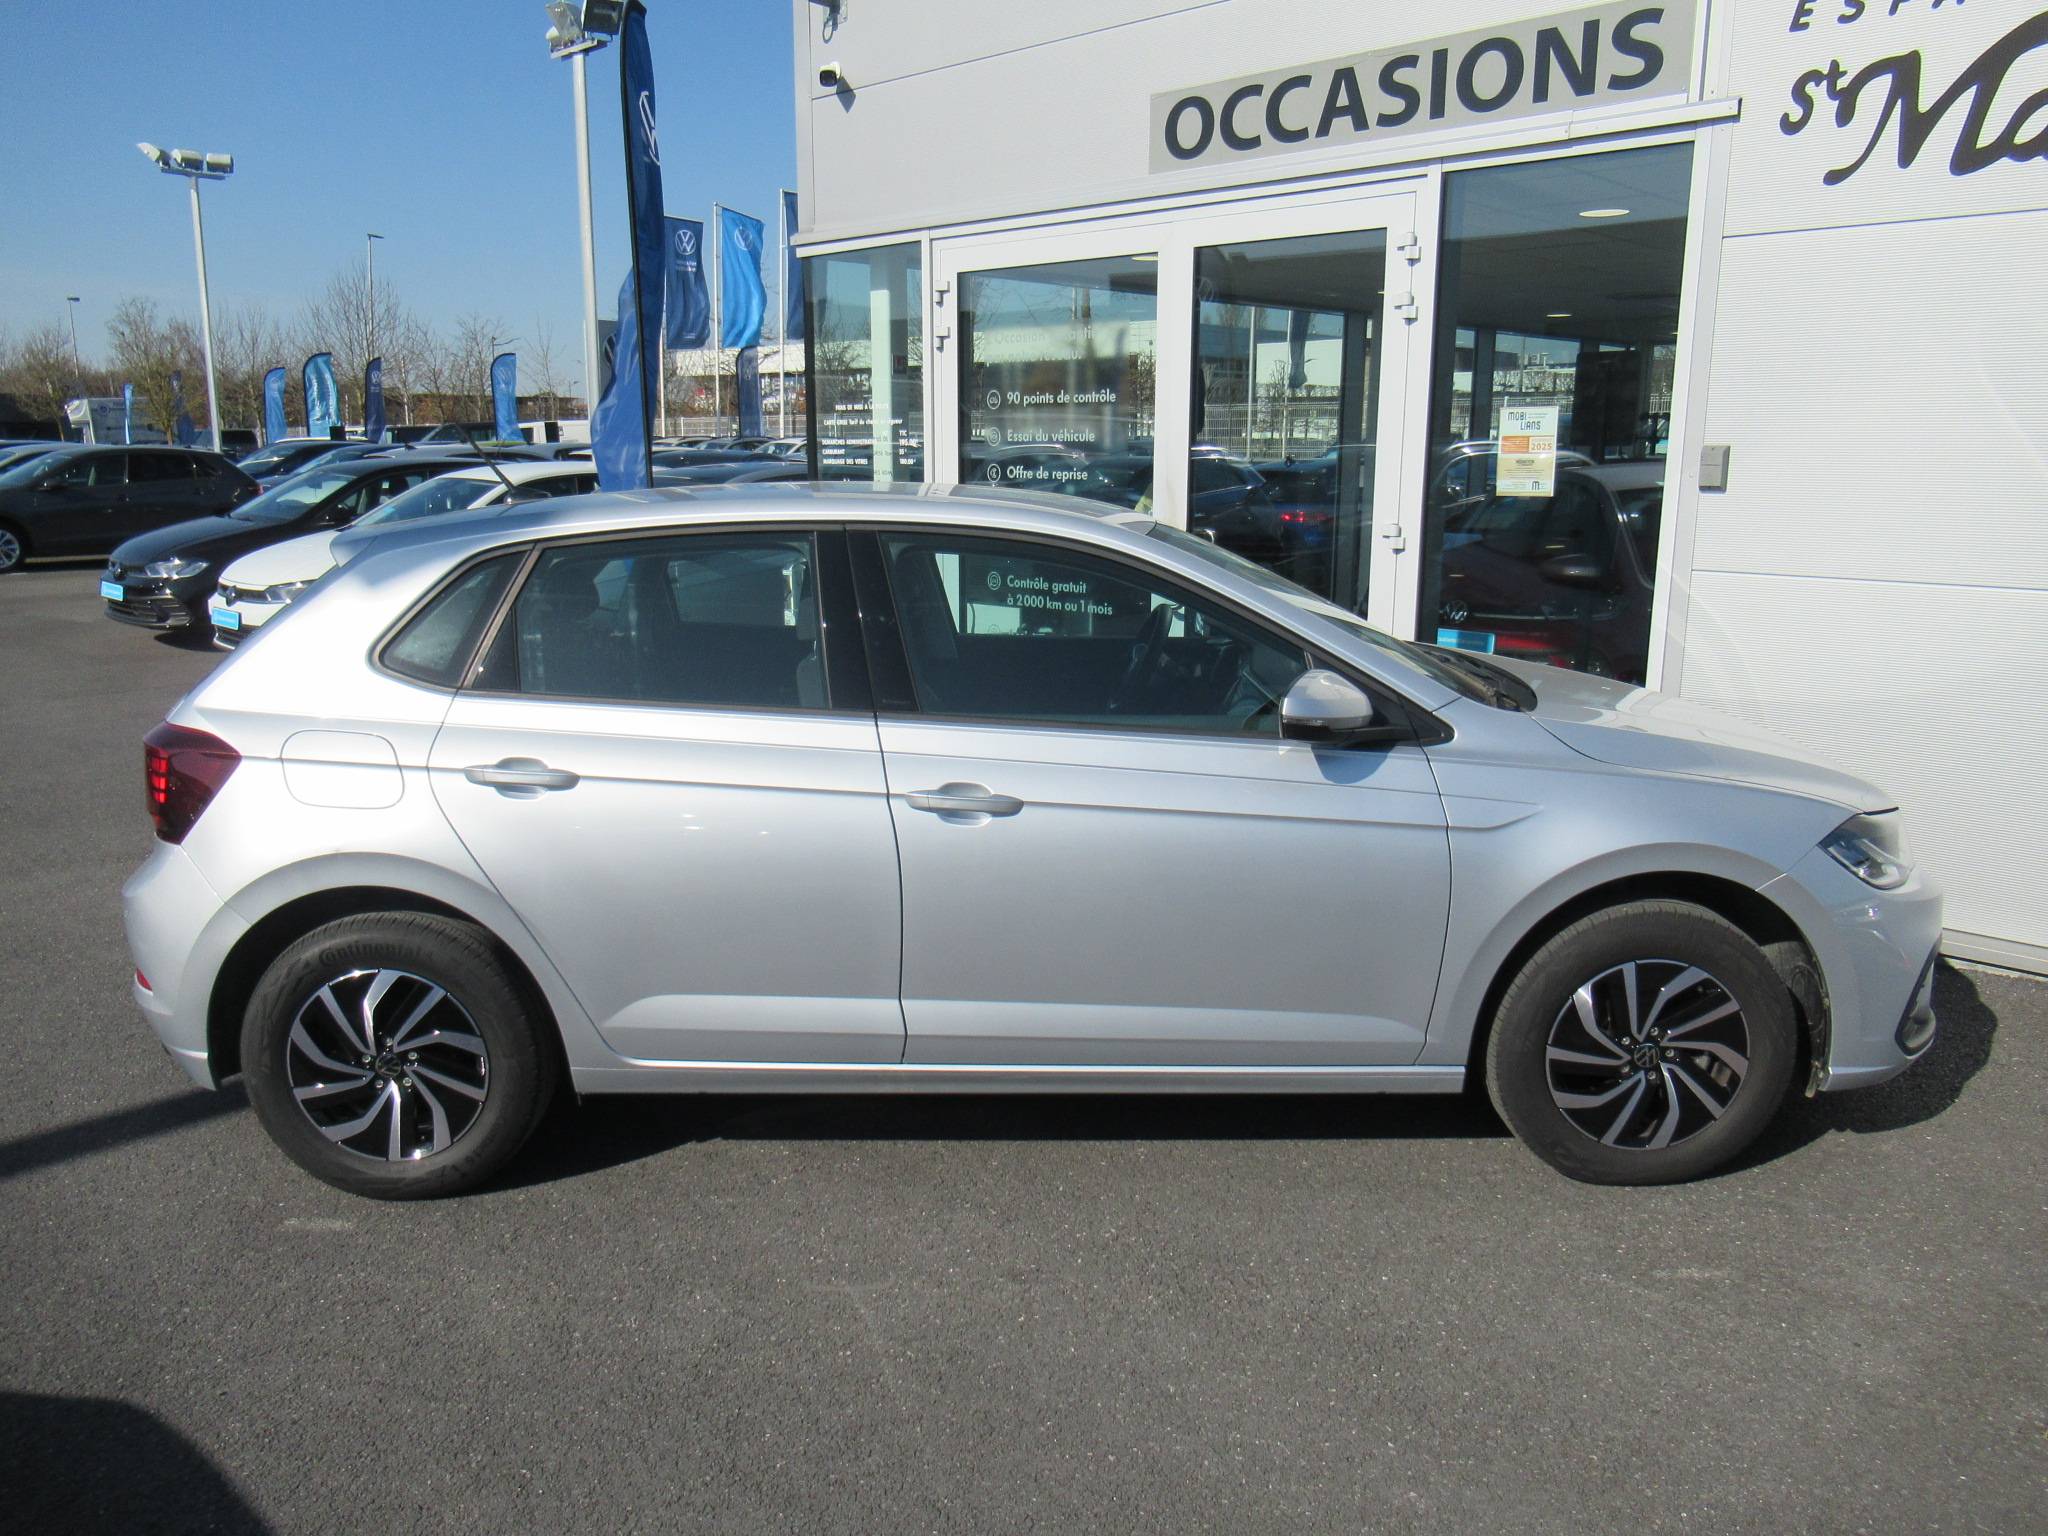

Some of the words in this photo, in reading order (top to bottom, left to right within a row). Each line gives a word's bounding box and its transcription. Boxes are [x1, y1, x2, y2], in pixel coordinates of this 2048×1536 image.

[1165, 7, 1664, 161] OCCASIONS
[1006, 391, 1021, 405] 90
[1023, 391, 1054, 408] points
[1056, 389, 1071, 404] de
[1073, 387, 1116, 403] contrôle
[1007, 428, 1032, 442] Essai
[1035, 427, 1049, 442] du
[1051, 427, 1096, 442] véhicule
[1006, 465, 1033, 479] Offre
[1036, 466, 1049, 480] de
[1052, 467, 1088, 483] reprise
[1007, 575, 1049, 590] Contrôle
[1052, 581, 1087, 595] gratuit
[1007, 593, 1014, 606] à
[1046, 596, 1062, 610] km
[1064, 600, 1078, 612] ou
[1087, 602, 1113, 616] mois
